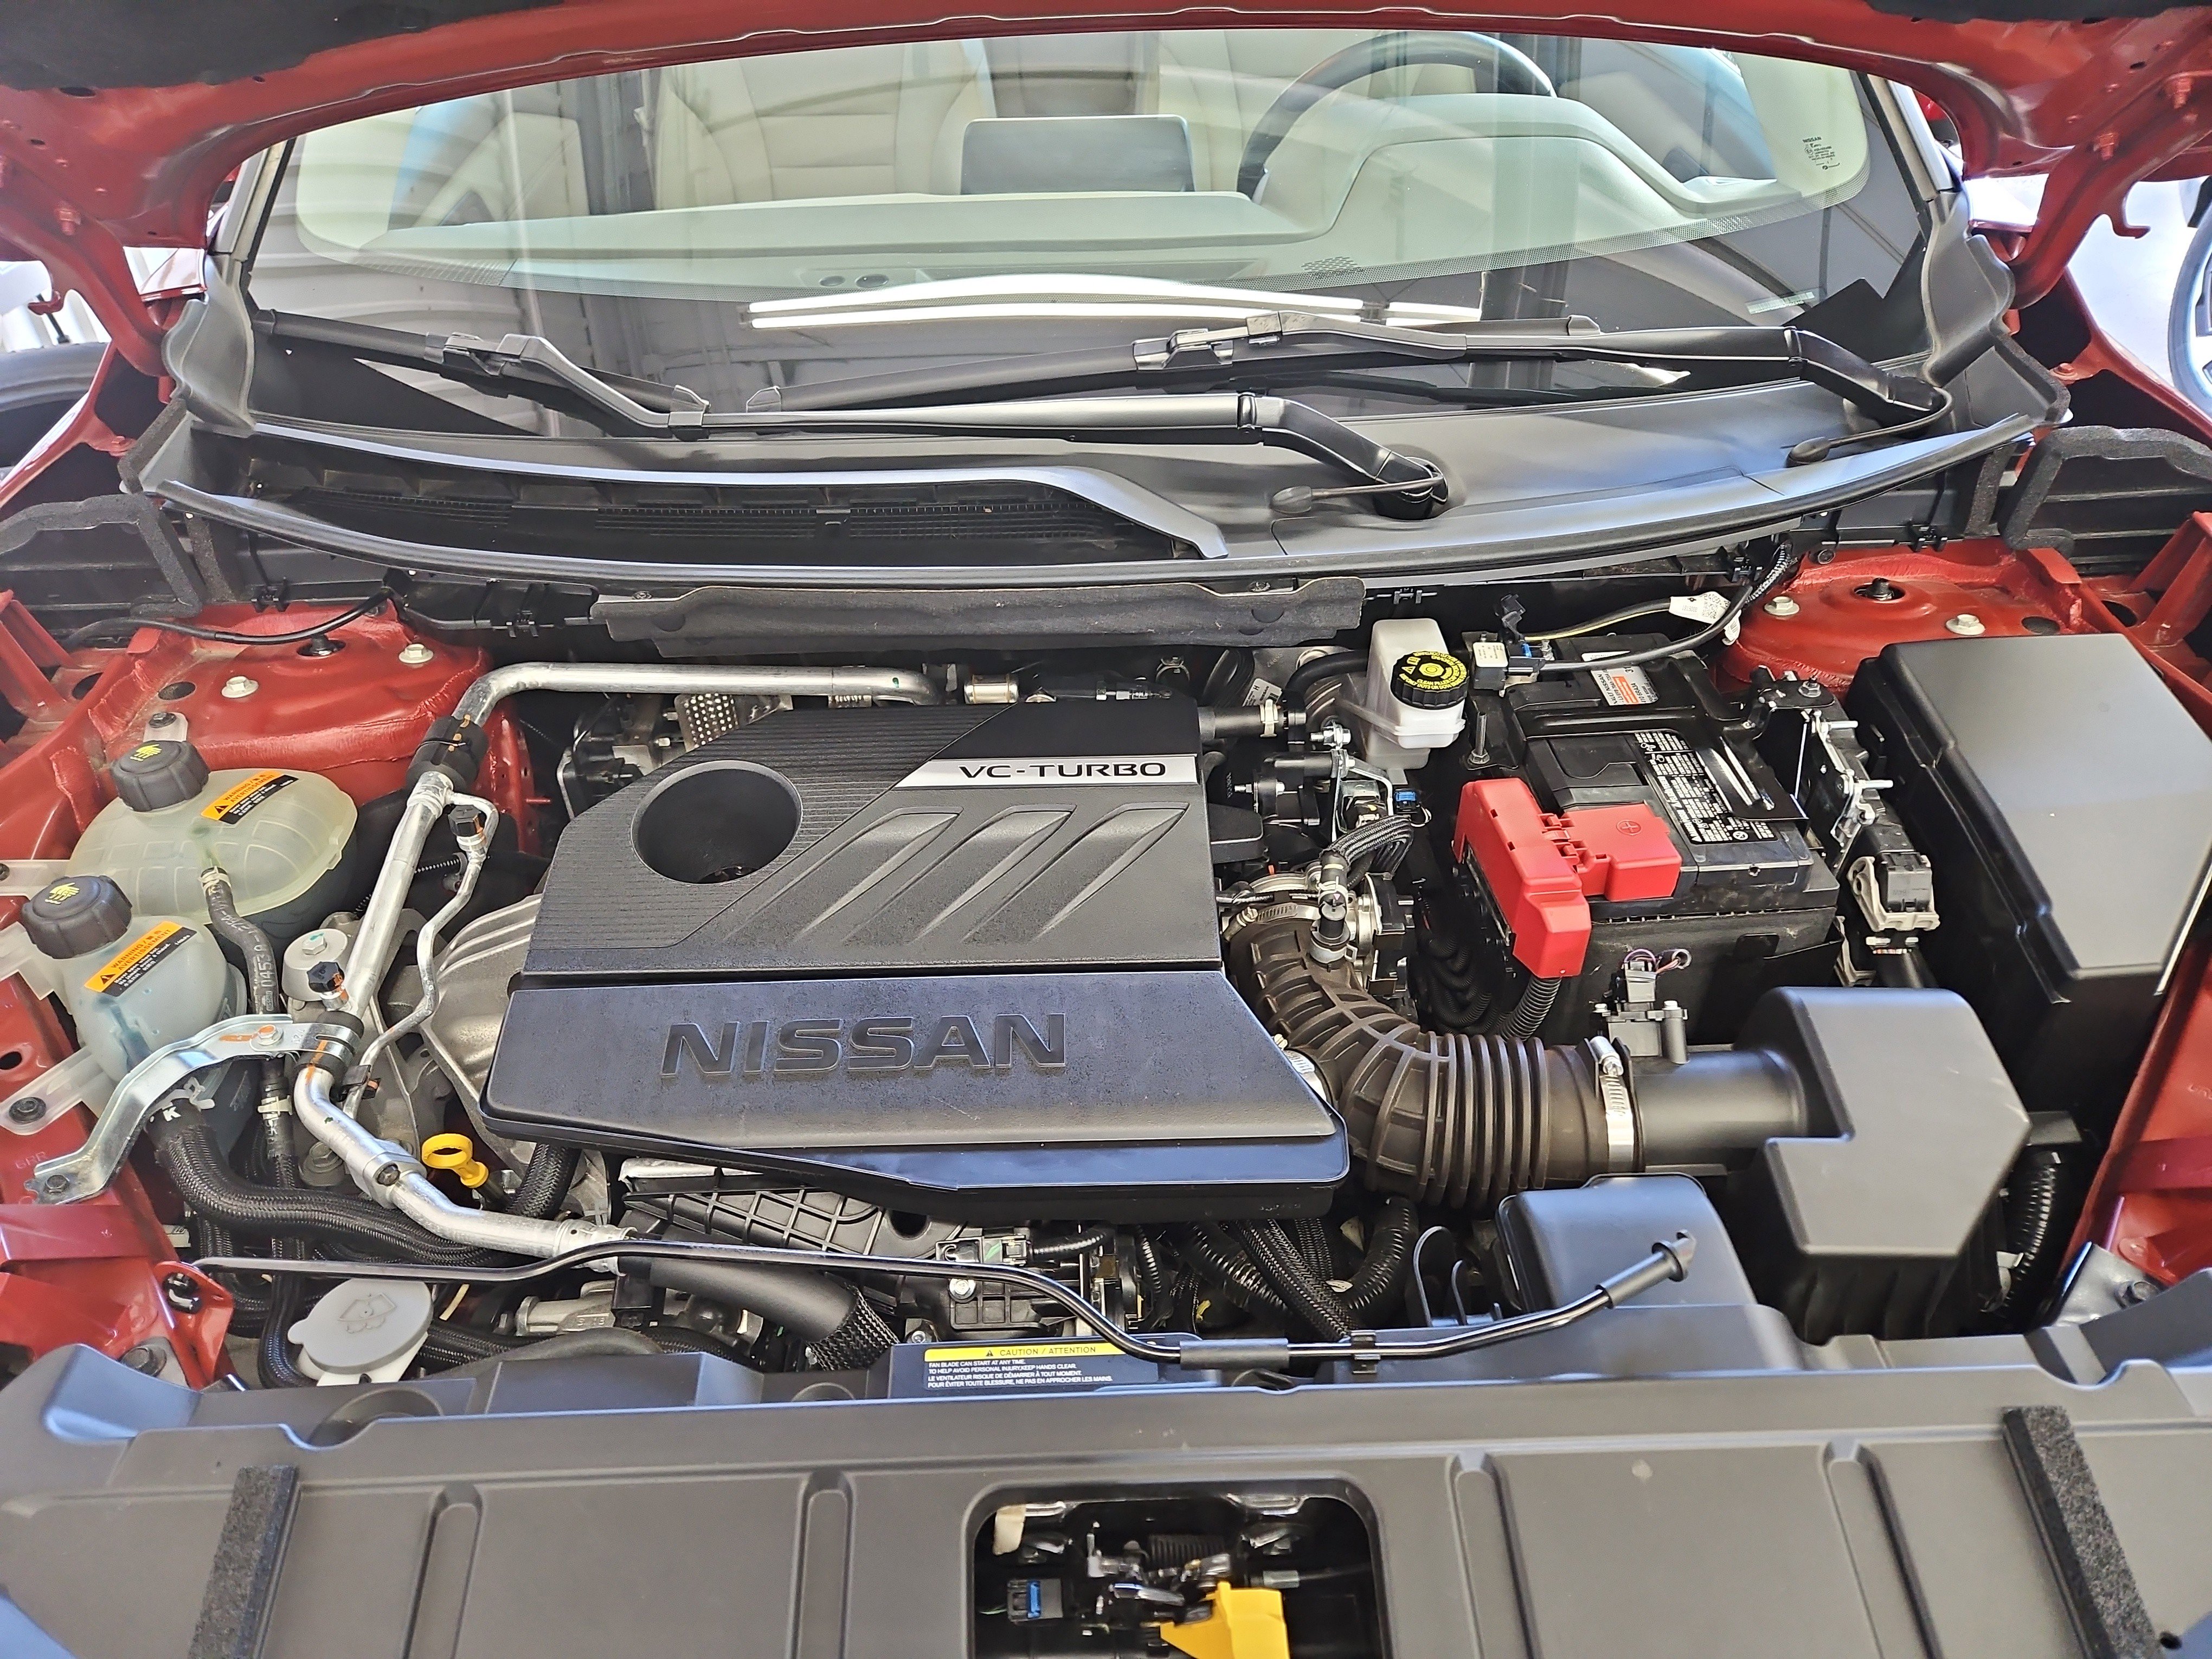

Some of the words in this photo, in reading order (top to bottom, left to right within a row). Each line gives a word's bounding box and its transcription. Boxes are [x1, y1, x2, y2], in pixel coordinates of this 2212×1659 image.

[958, 762, 1166, 779] VC-TURBO
[223, 783, 250, 801] WARNING
[111, 943, 144, 969] WARNING
[118, 929, 171, 970] AVERTISSEMENT
[661, 1013, 1066, 1077] NISSAN
